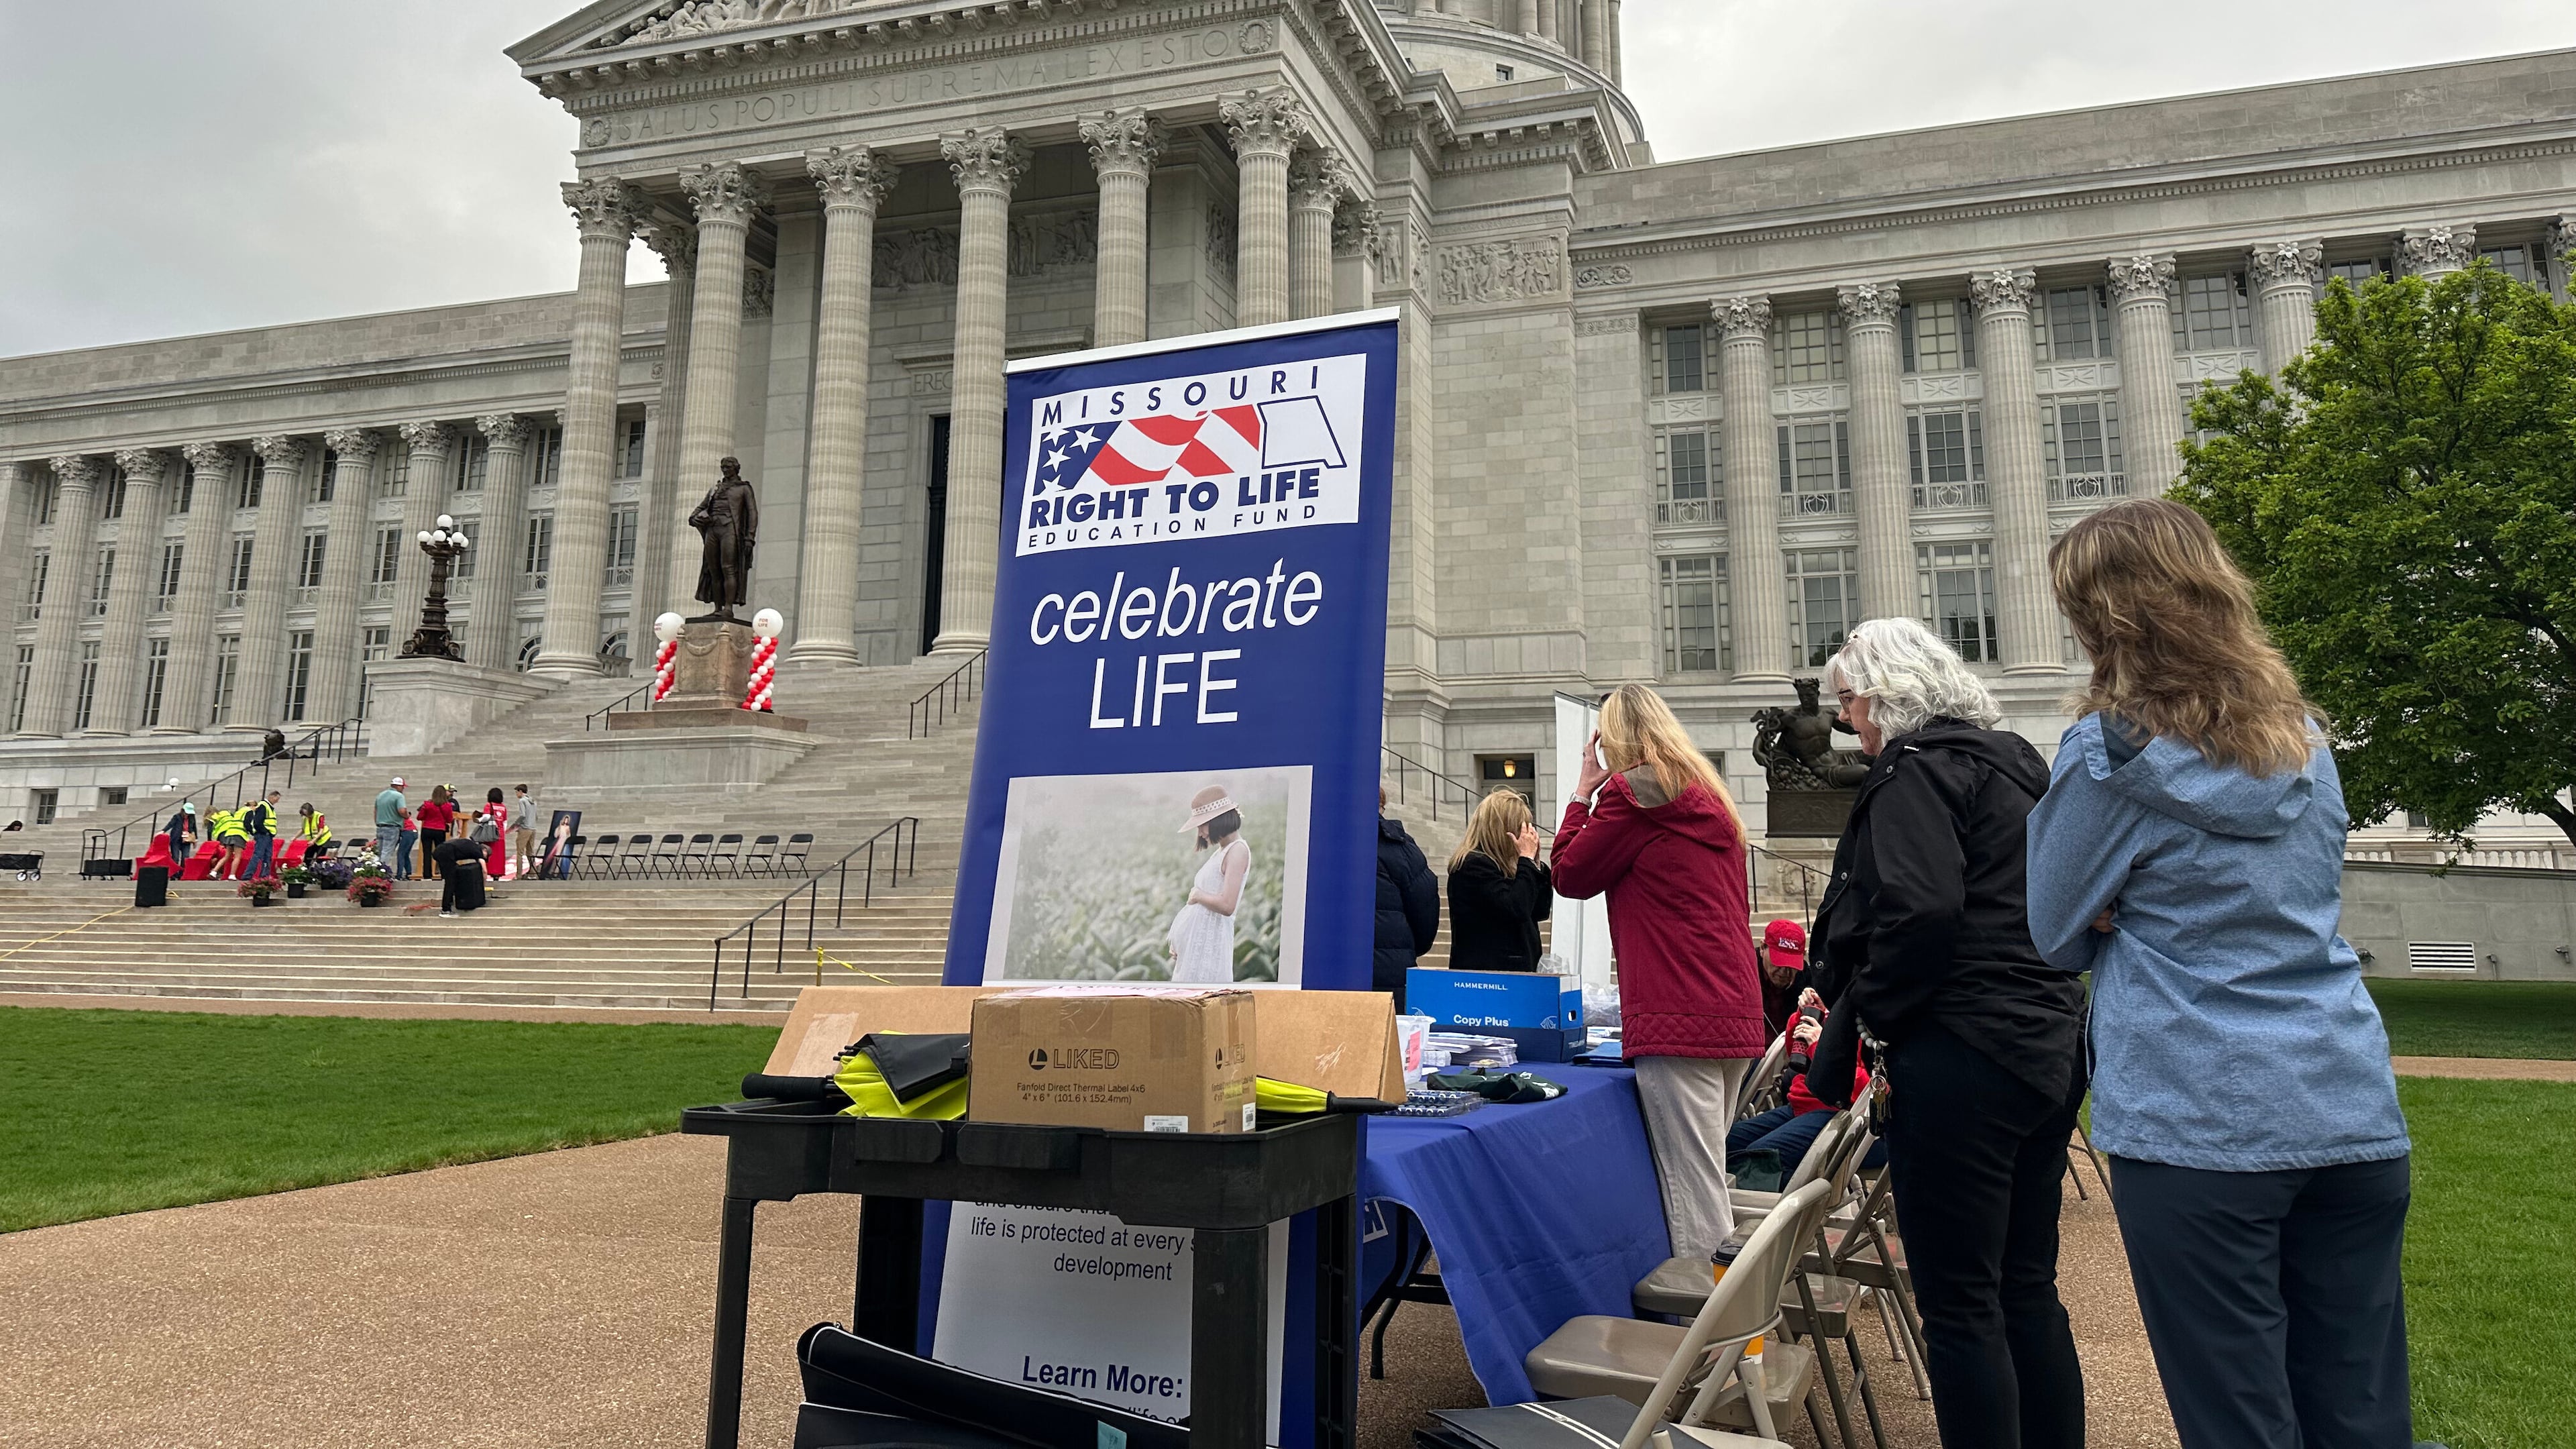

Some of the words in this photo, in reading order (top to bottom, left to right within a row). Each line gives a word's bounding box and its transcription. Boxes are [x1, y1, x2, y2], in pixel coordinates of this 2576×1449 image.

[619, 103, 720, 140] SALUS
[734, 85, 854, 126] POPULI
[868, 57, 1048, 107] SUPREMA
[1063, 44, 1125, 80] LEX
[1142, 30, 1229, 68] ESTO
[1041, 366, 1318, 427] MISSOURI
[1028, 488, 1149, 529] RIGHT
[1165, 481, 1220, 514] TO
[1238, 468, 1320, 506] LIFE
[1028, 517, 1206, 548] EDUCATION
[1234, 505, 1316, 527] FUND
[1029, 557, 1323, 646] celebrate
[1089, 648, 1242, 729] LIFE
[1454, 981, 1509, 991] HAMMERMILL
[1453, 1014, 1482, 1027] Copy
[1053, 1048, 1120, 1069] LIKED
[1017, 1083, 1045, 1092] Fanfold
[1048, 1083, 1071, 1092] Direct
[1073, 1083, 1106, 1093] Thermal
[1108, 1084, 1129, 1093] Label
[1130, 1084, 1146, 1093] 4x6
[1090, 1094, 1132, 1105] 152.4mm)
[971, 1216, 996, 1236] life
[1002, 1219, 1016, 1238] is
[1021, 1223, 1106, 1244] protected
[1111, 1228, 1128, 1247] at
[1134, 1233, 1185, 1256] every
[1054, 1252, 1173, 1281] development
[1022, 1355, 1097, 1389] Learn
[1106, 1364, 1183, 1399] More:
